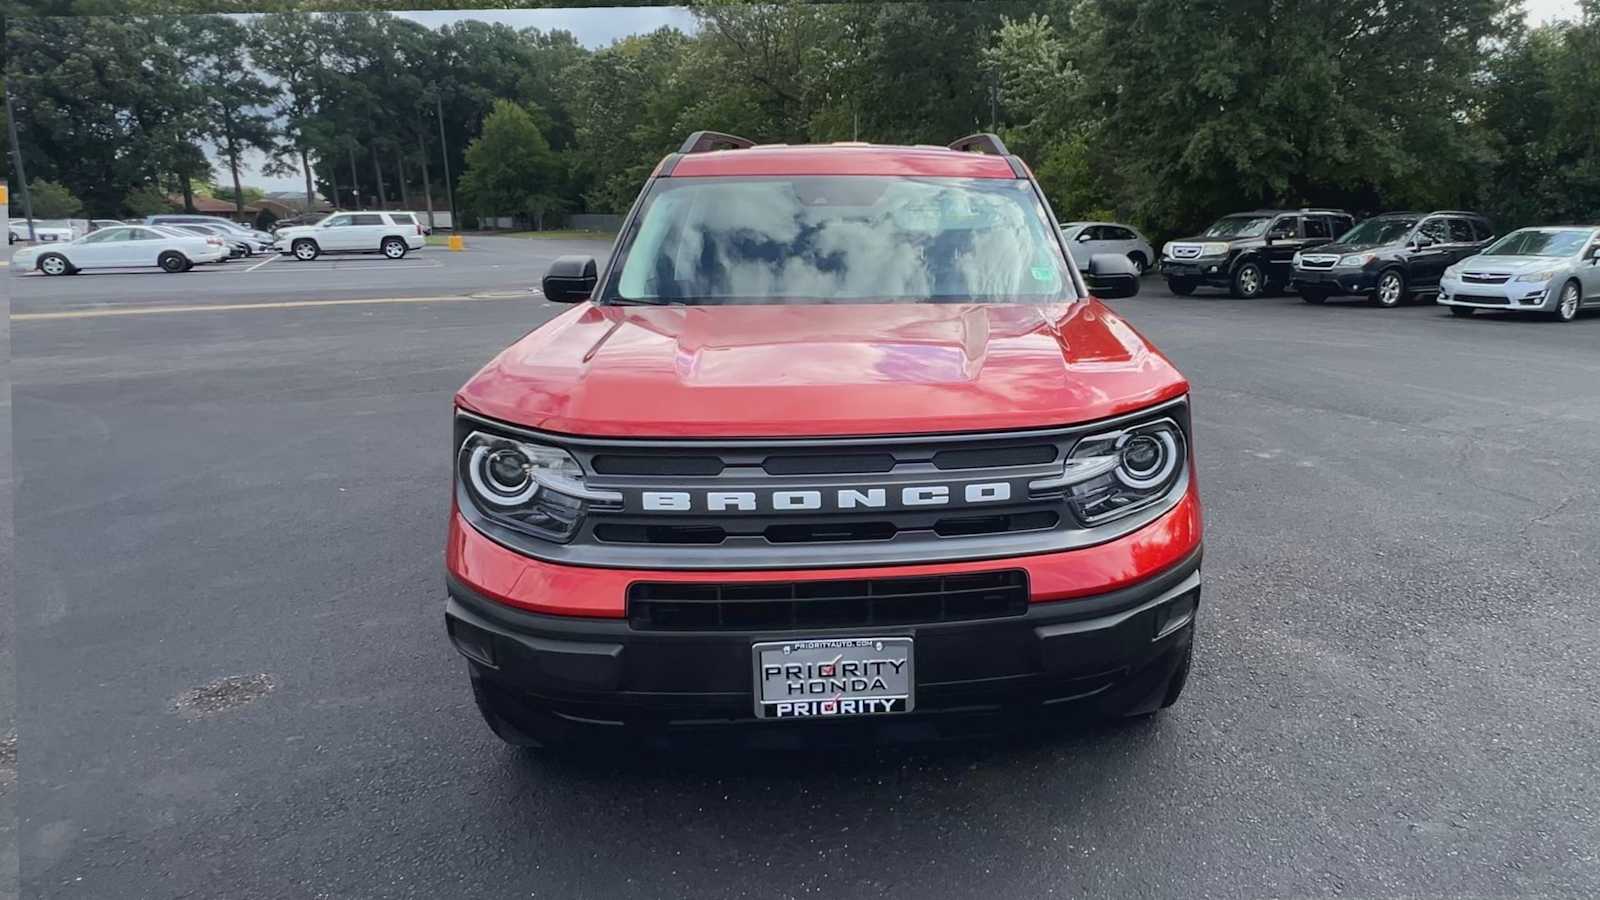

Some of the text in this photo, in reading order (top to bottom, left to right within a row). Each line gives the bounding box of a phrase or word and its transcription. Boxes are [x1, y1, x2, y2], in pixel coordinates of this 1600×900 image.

[642, 481, 1011, 511] BRONCO
[794, 640, 873, 650] PRIORITYAUTO.COM
[764, 658, 907, 681] PRIORITY
[787, 677, 887, 696] HONDA
[776, 699, 896, 717] PRIORITY
